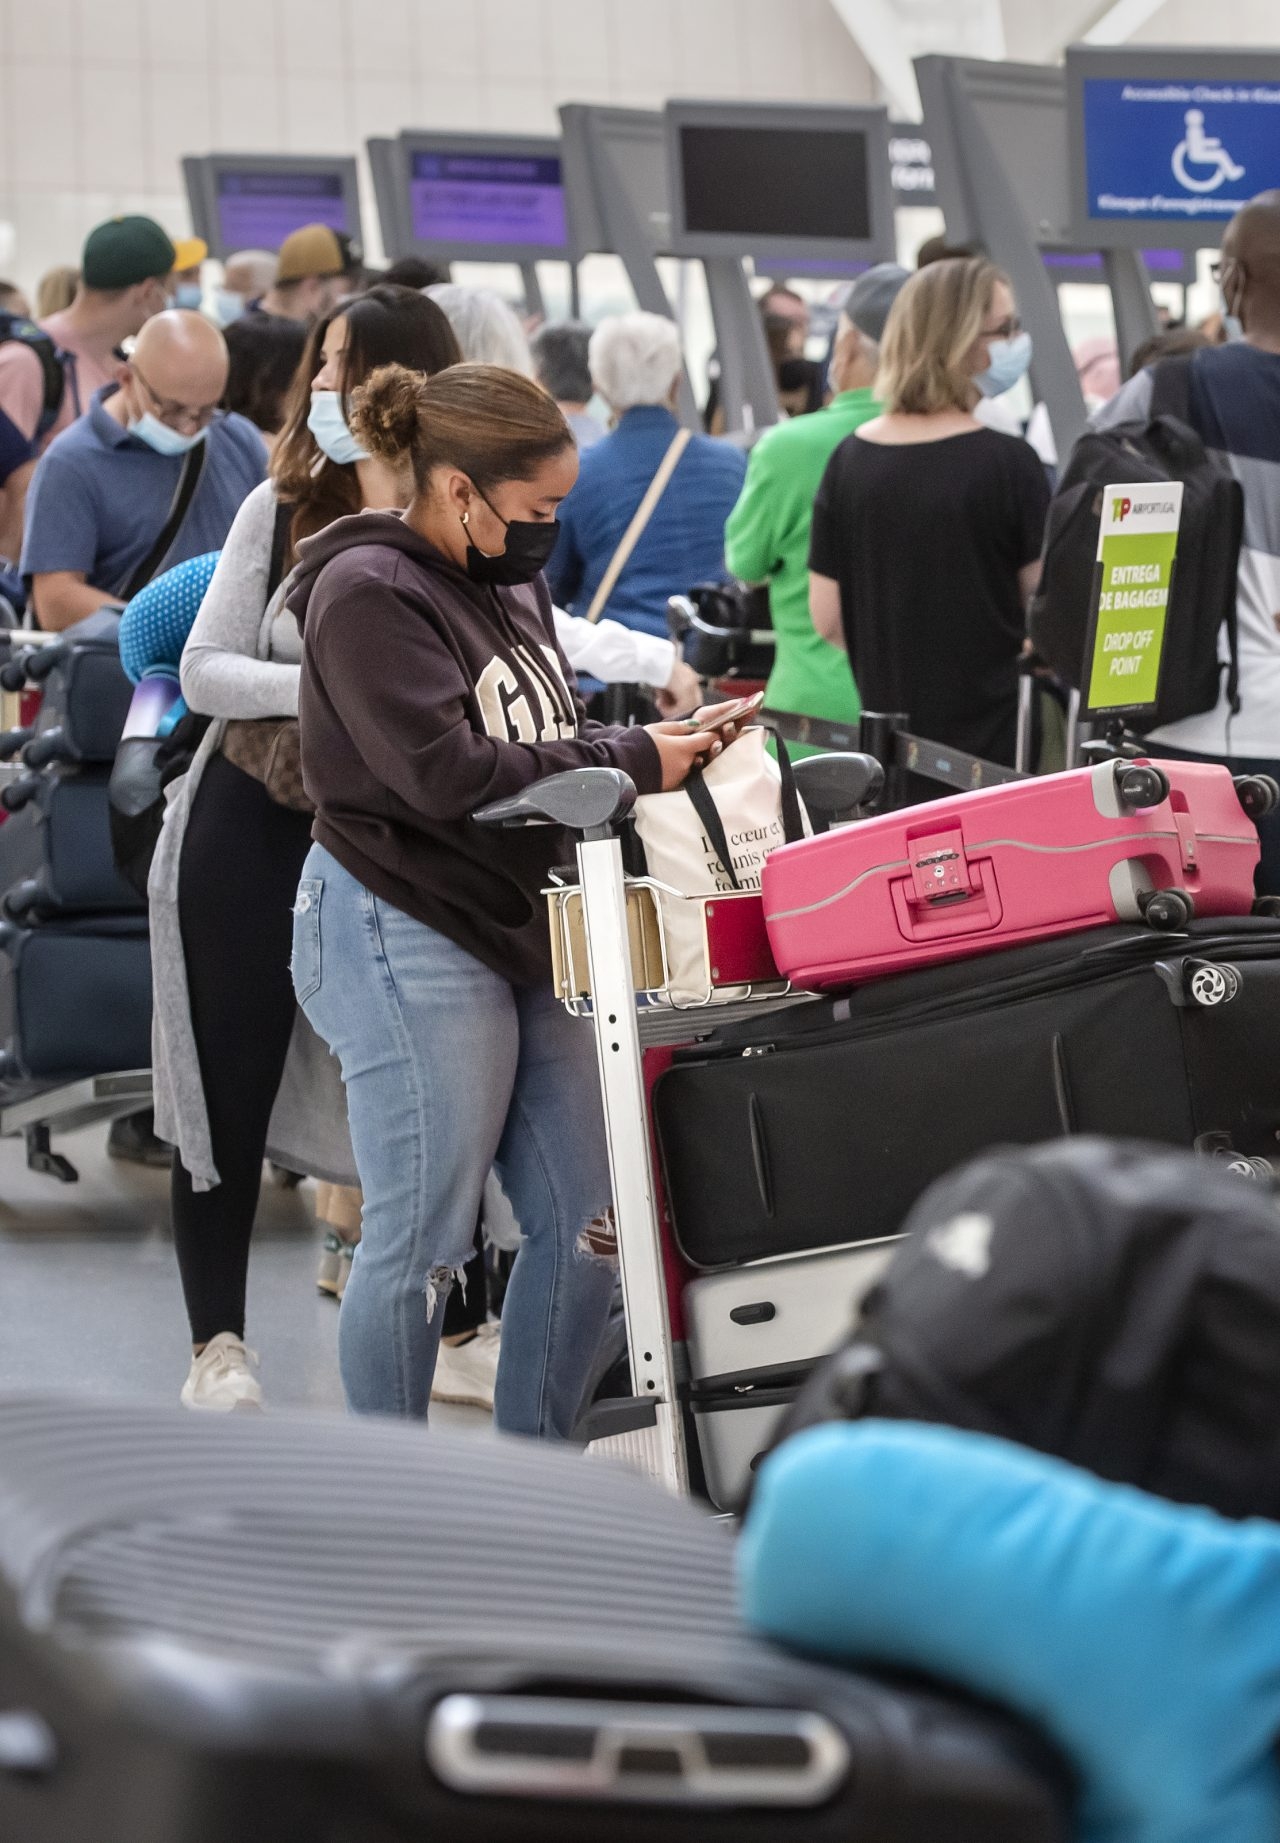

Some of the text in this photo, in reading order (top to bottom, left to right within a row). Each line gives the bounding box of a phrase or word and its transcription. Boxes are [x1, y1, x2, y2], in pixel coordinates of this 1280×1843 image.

[1121, 85, 1190, 102] Accessible
[1110, 564, 1161, 586] ENTREGA
[1099, 591, 1113, 612] DE
[1103, 629, 1154, 653] DROP OFF
[1109, 655, 1143, 677] POINT
[731, 826, 768, 846] cœur
